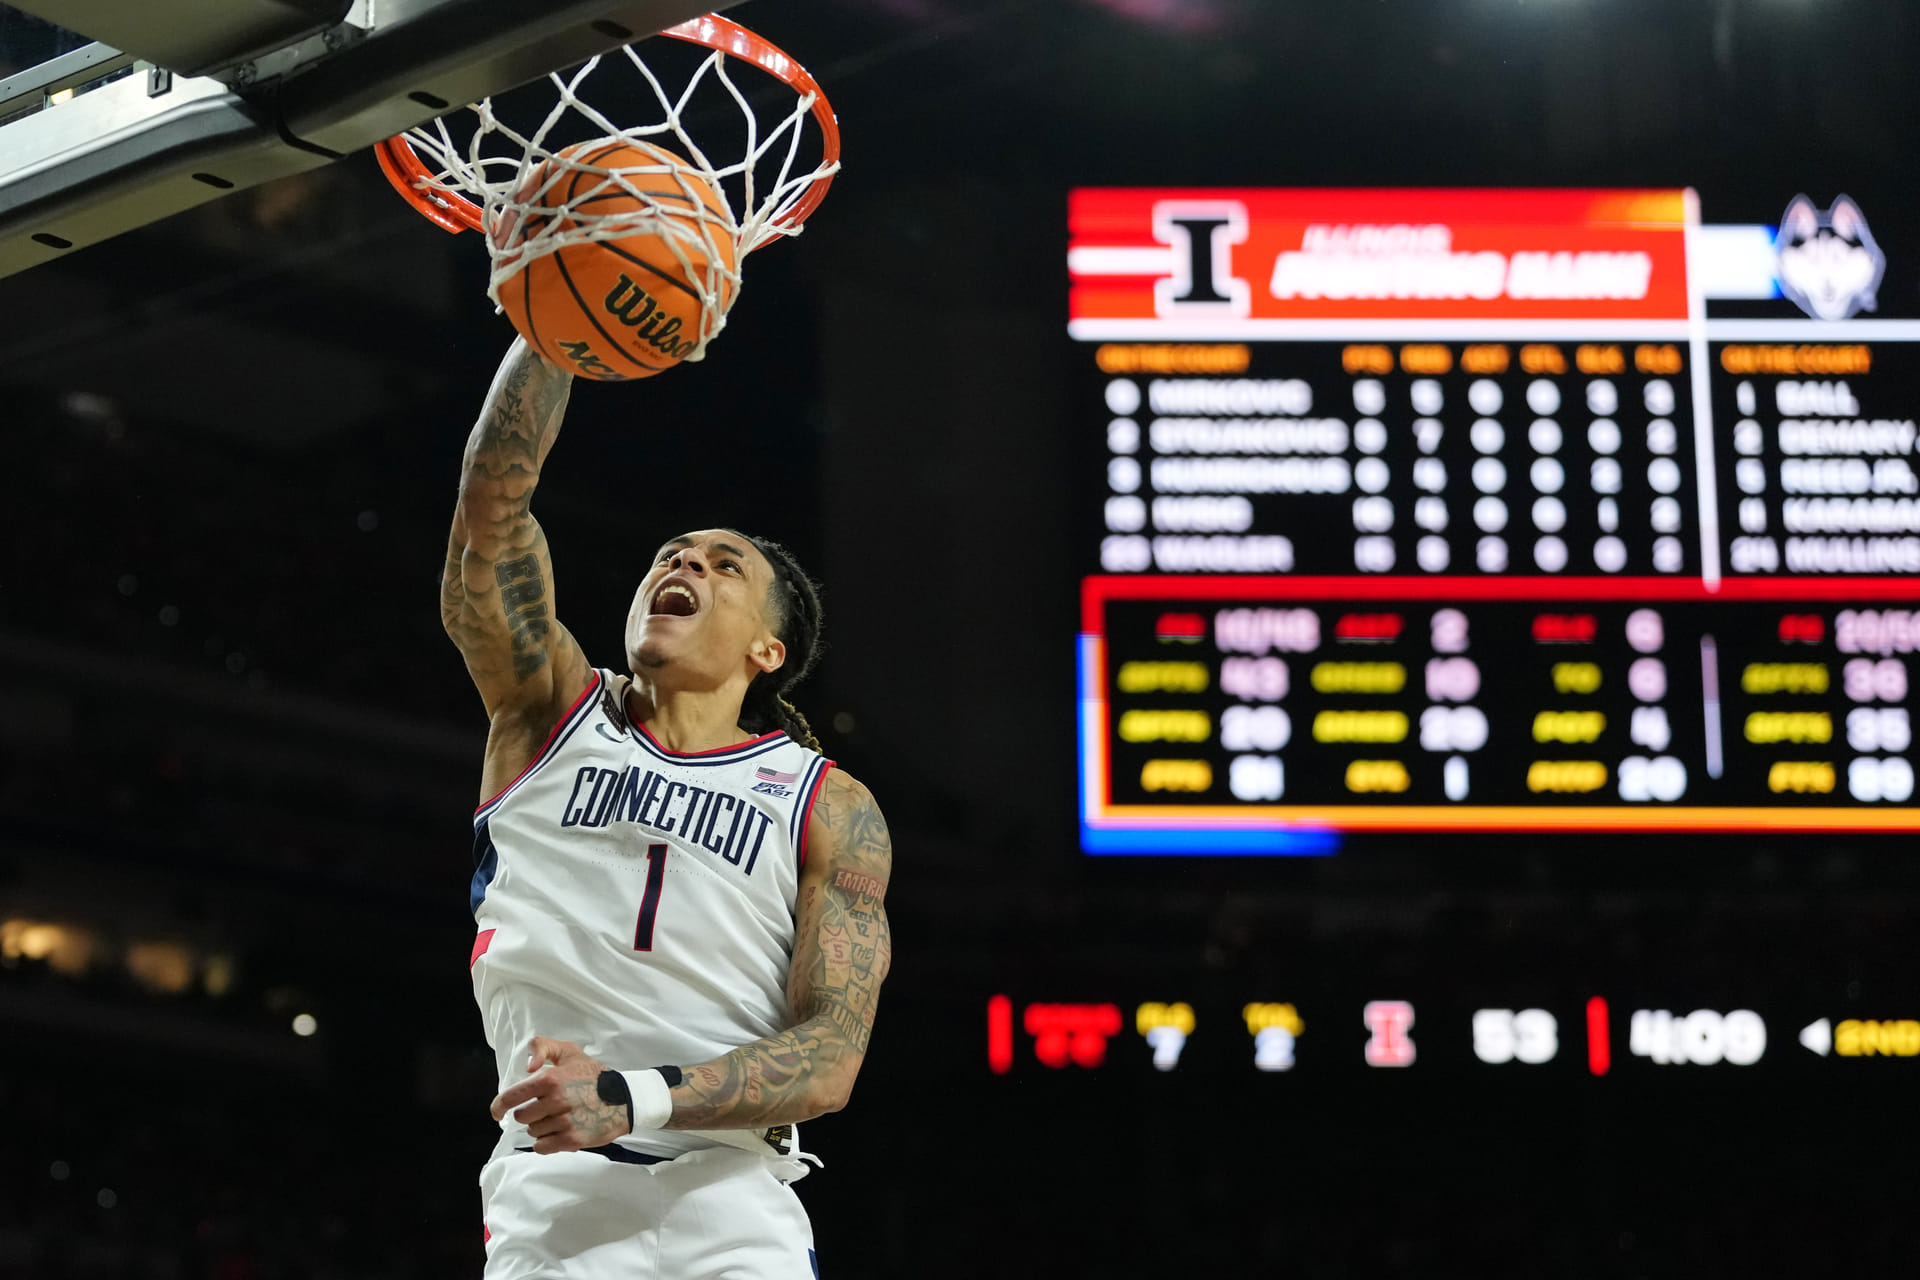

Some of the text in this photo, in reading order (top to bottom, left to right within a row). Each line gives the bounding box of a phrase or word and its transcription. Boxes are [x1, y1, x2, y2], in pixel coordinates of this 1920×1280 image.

[605, 272, 698, 358] Wilso
[1776, 381, 1860, 416] BALL
[1782, 497, 1920, 533] KARABA
[751, 785, 794, 797] EAST
[757, 781, 788, 790] BIG
[634, 844, 668, 952] 1
[1472, 1009, 1558, 1064] 53
